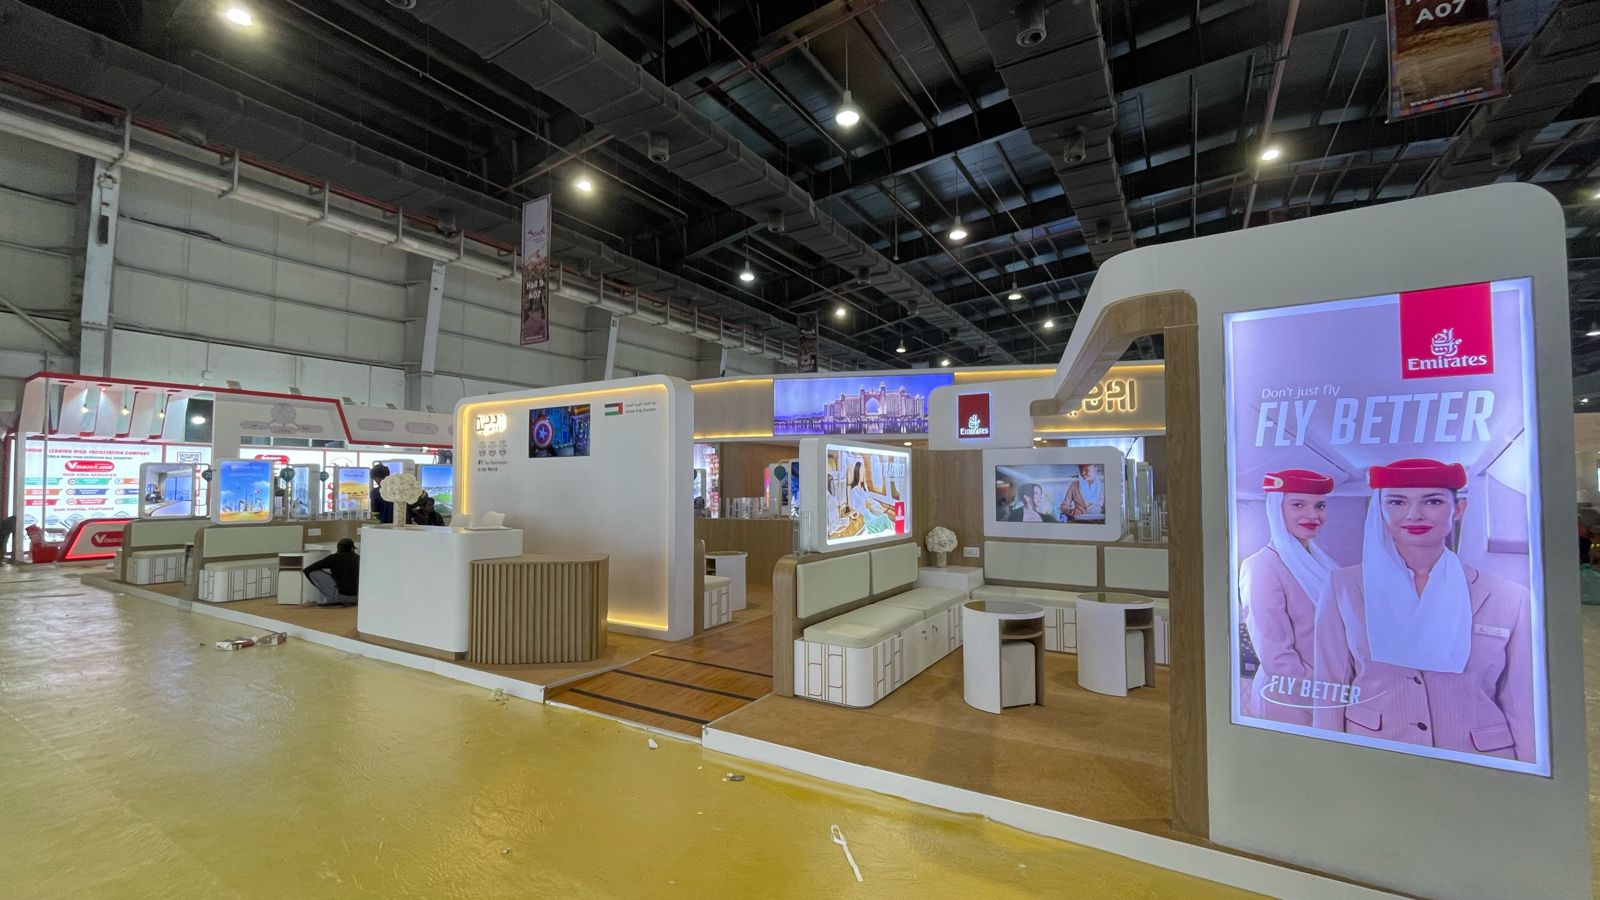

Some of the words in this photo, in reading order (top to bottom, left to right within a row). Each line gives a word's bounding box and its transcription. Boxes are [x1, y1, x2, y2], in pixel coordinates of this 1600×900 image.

[1415, 0, 1466, 24] A07
[1407, 355, 1488, 371] Emirates
[1261, 387, 1293, 399] Don't
[1294, 386, 1319, 399] just
[1323, 384, 1341, 397] fly
[1255, 399, 1318, 447] FLY
[1330, 390, 1495, 445] BETTER
[960, 427, 989, 435] Emirates
[1270, 675, 1296, 695] FLY
[1300, 679, 1360, 704] BETTER
